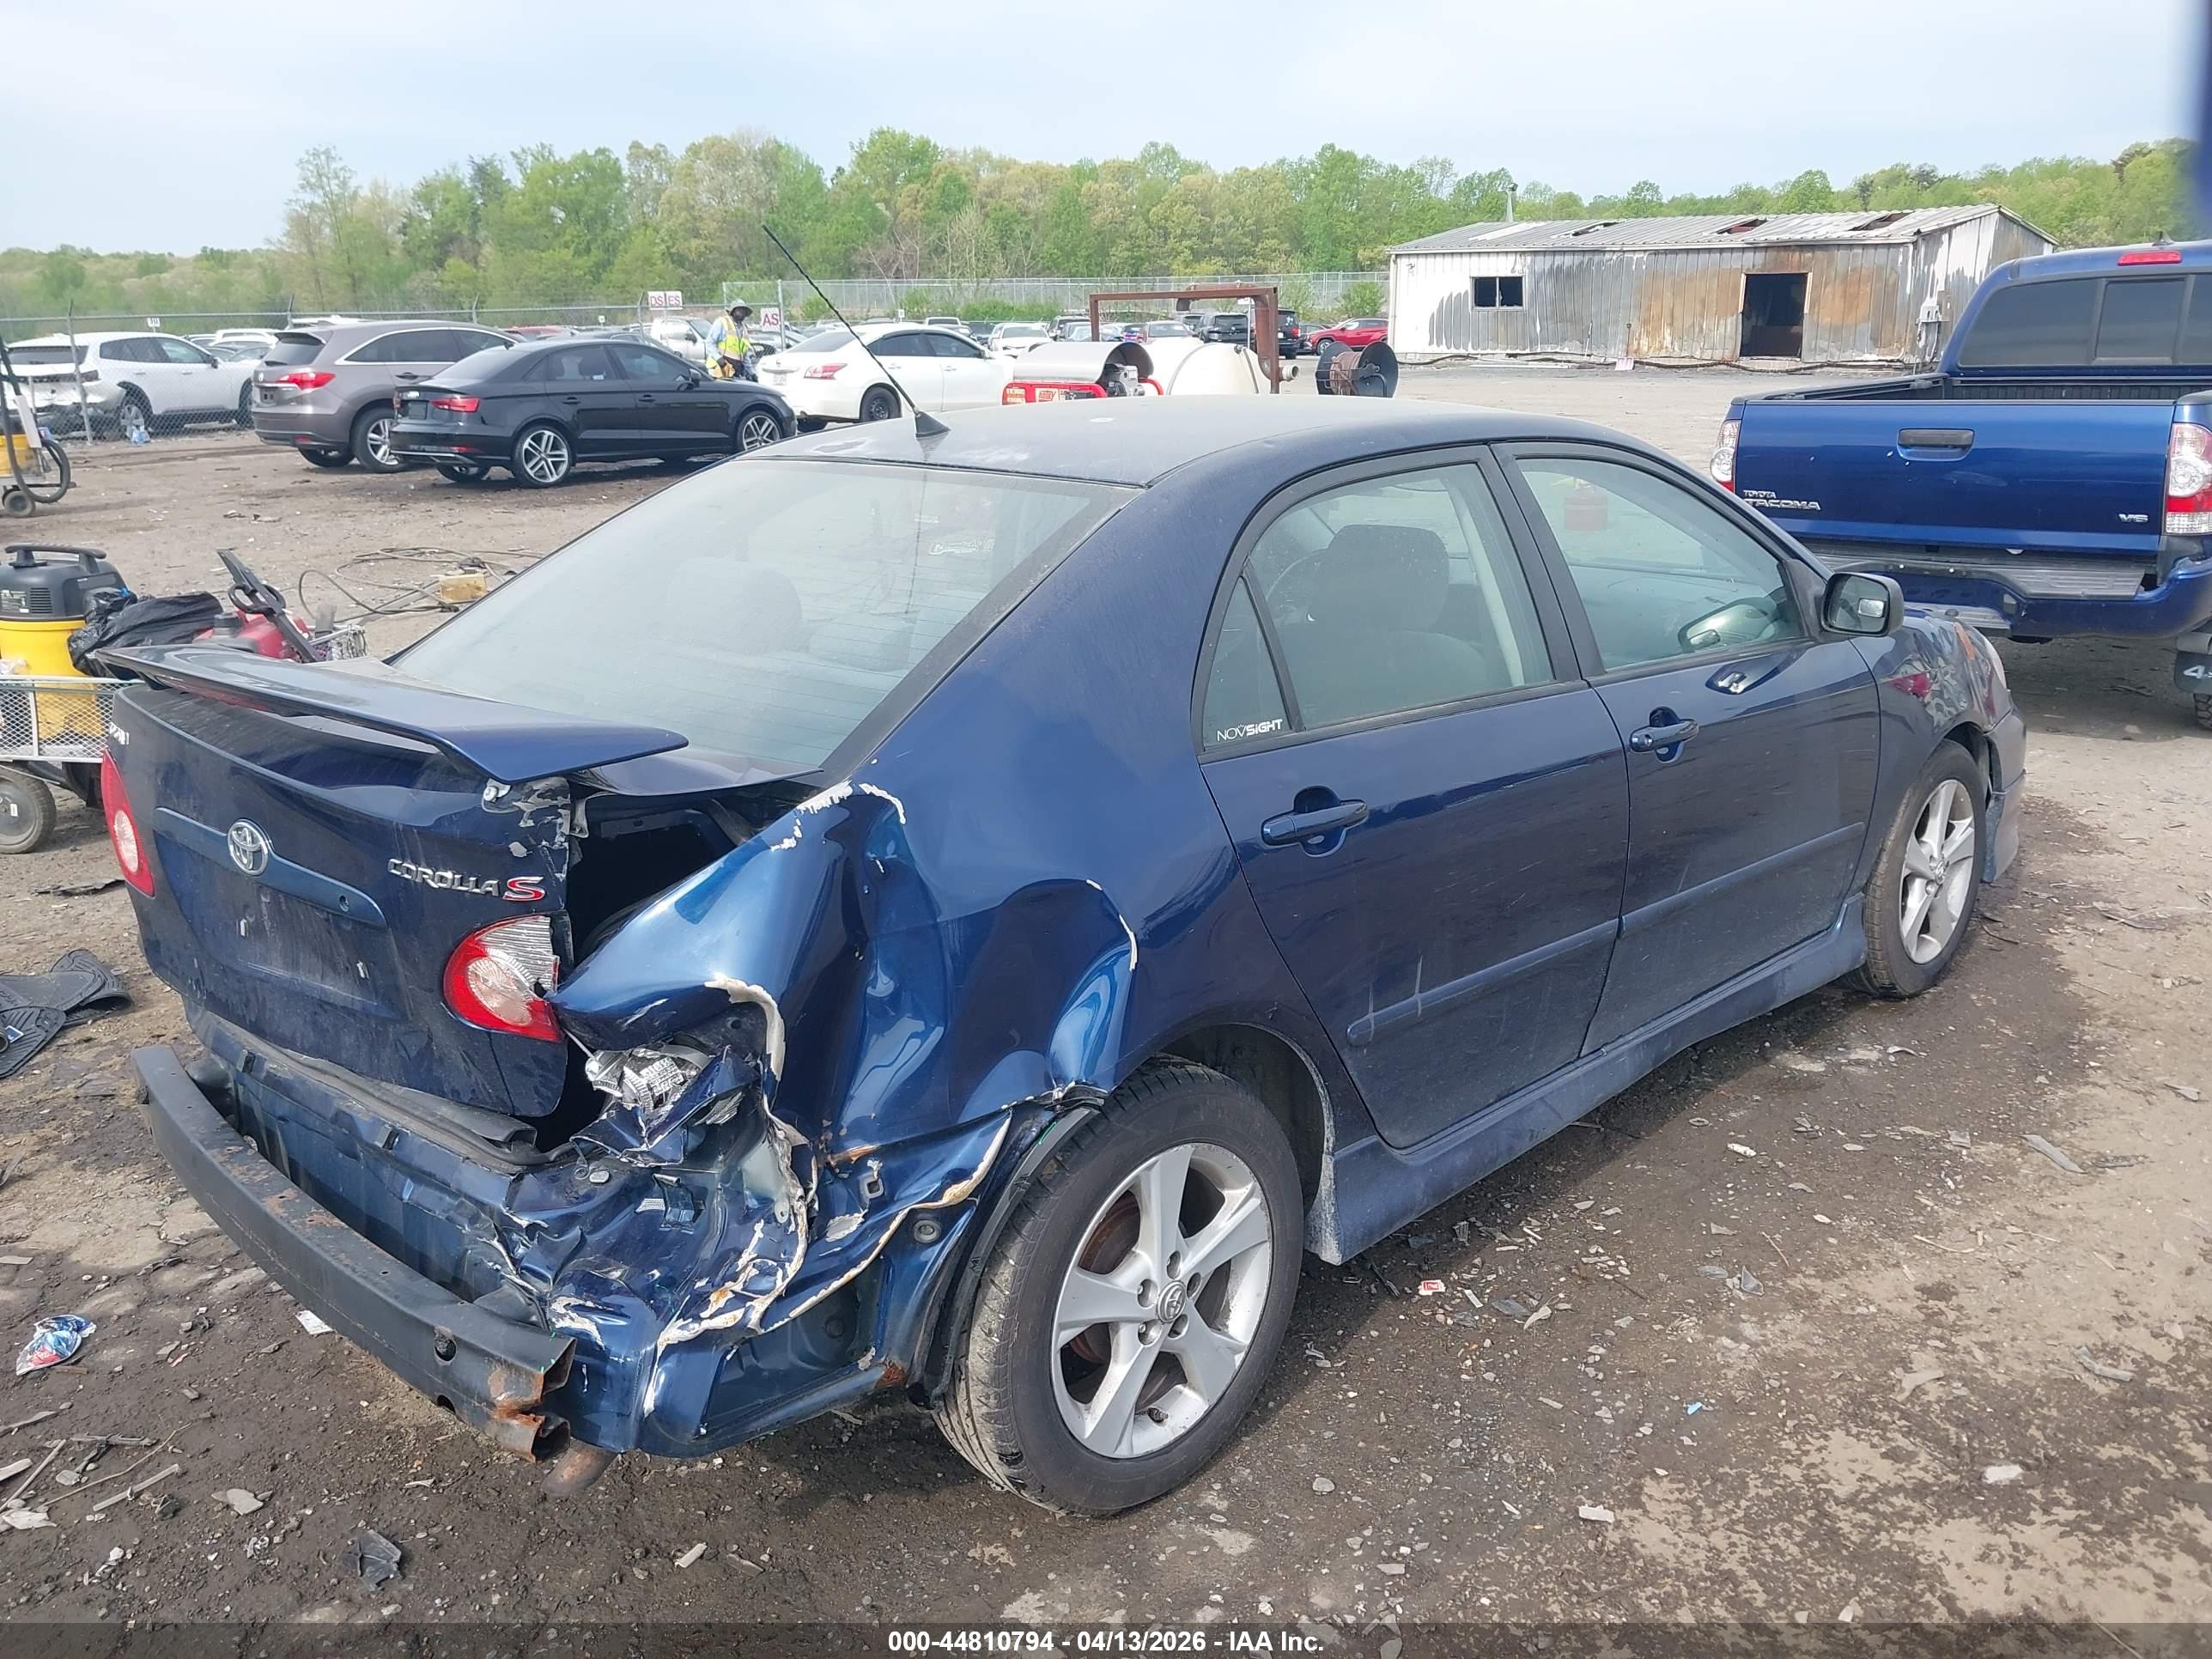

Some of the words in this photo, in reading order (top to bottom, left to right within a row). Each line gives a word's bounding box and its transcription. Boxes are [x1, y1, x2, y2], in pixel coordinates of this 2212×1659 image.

[763, 313, 780, 326] AS
[1742, 489, 1777, 499] TOYOTA
[1743, 498, 1821, 511] TACOMA
[2118, 514, 2148, 523] V6
[2183, 665, 2212, 679] 4
[387, 858, 501, 897] COROLLA
[501, 876, 546, 902] S
